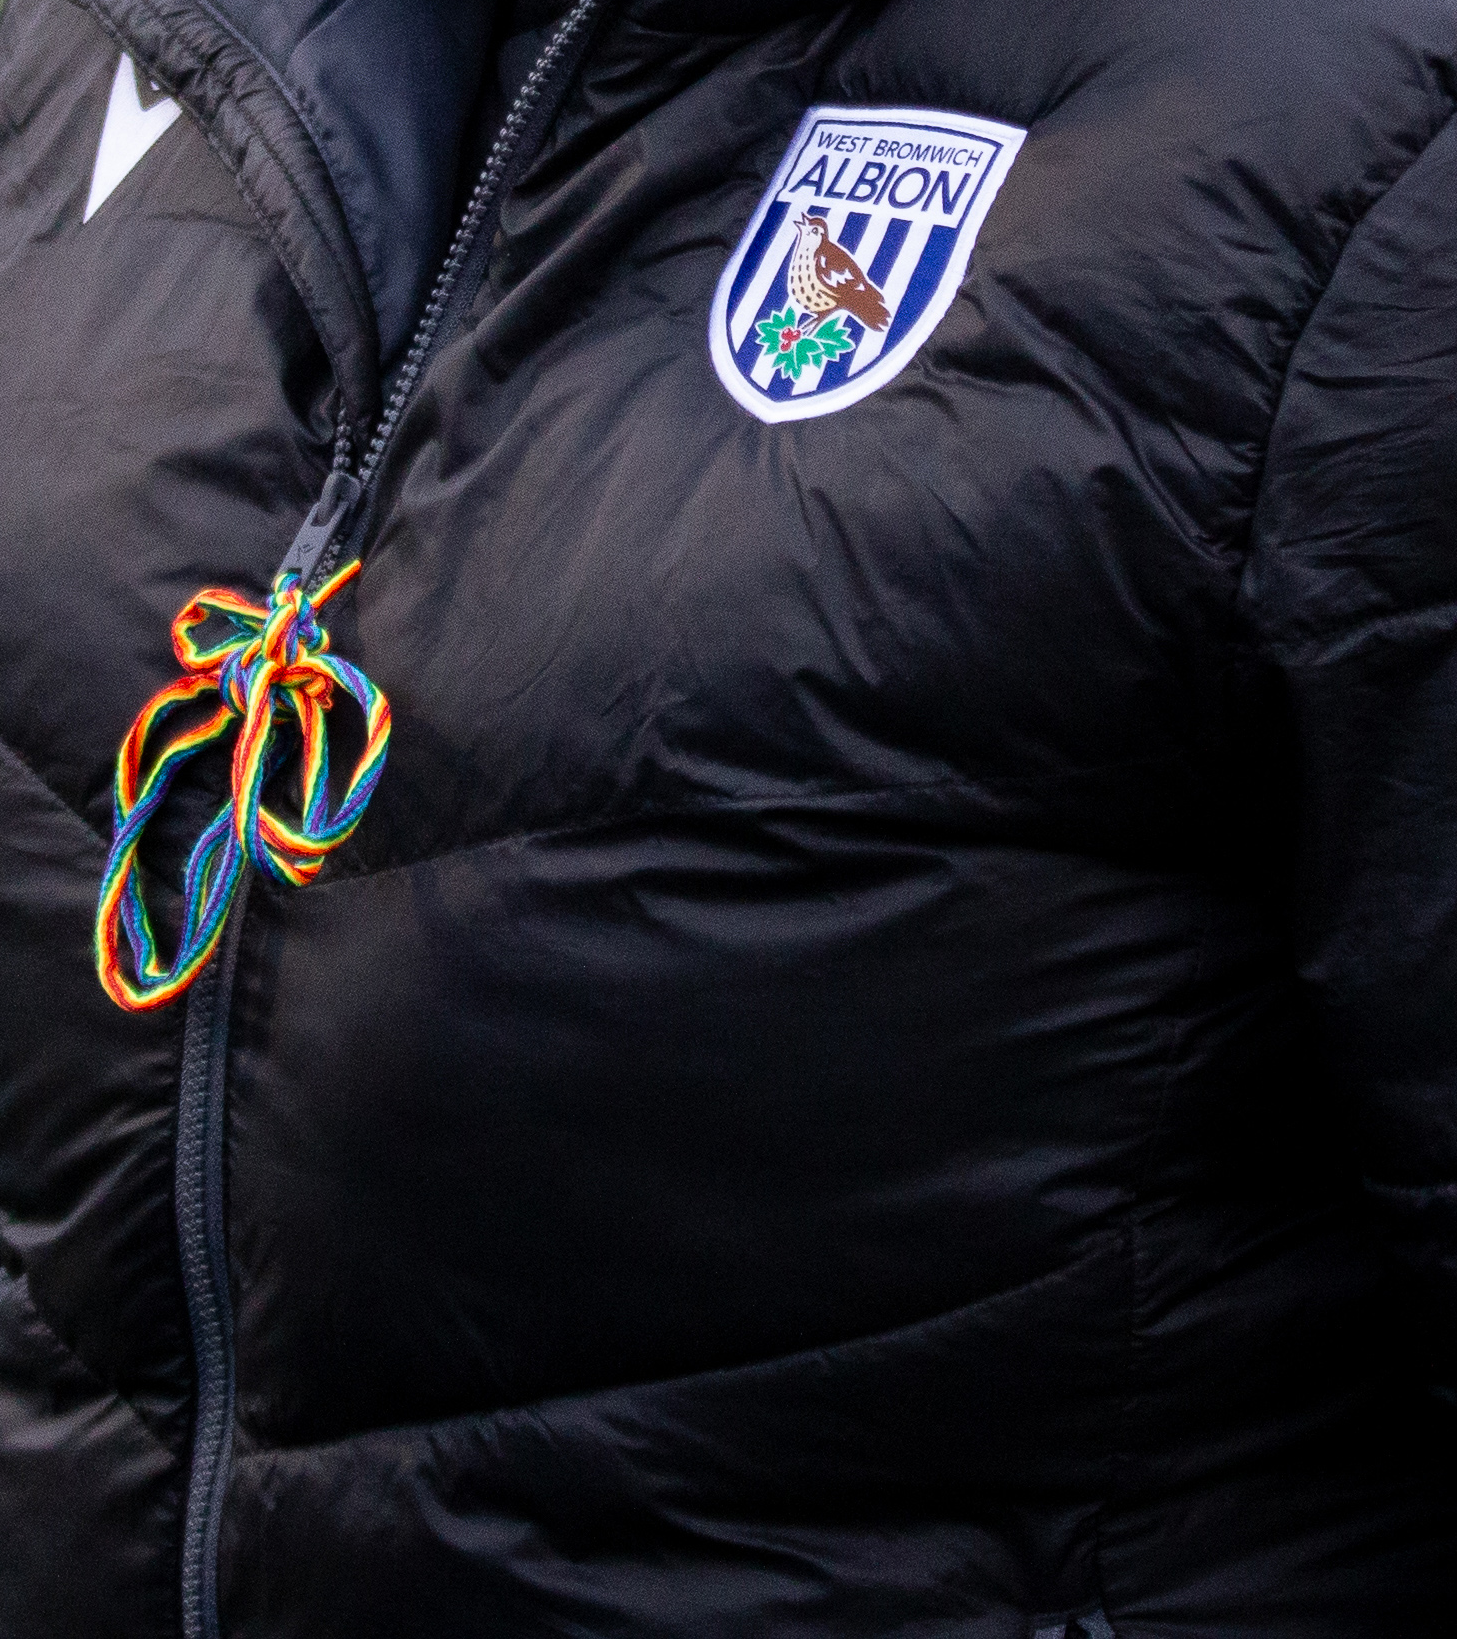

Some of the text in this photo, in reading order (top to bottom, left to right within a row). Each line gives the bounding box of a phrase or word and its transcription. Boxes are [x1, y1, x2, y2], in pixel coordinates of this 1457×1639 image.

[817, 131, 984, 168] WEST BROMWICH
[789, 155, 972, 215] ALBION
